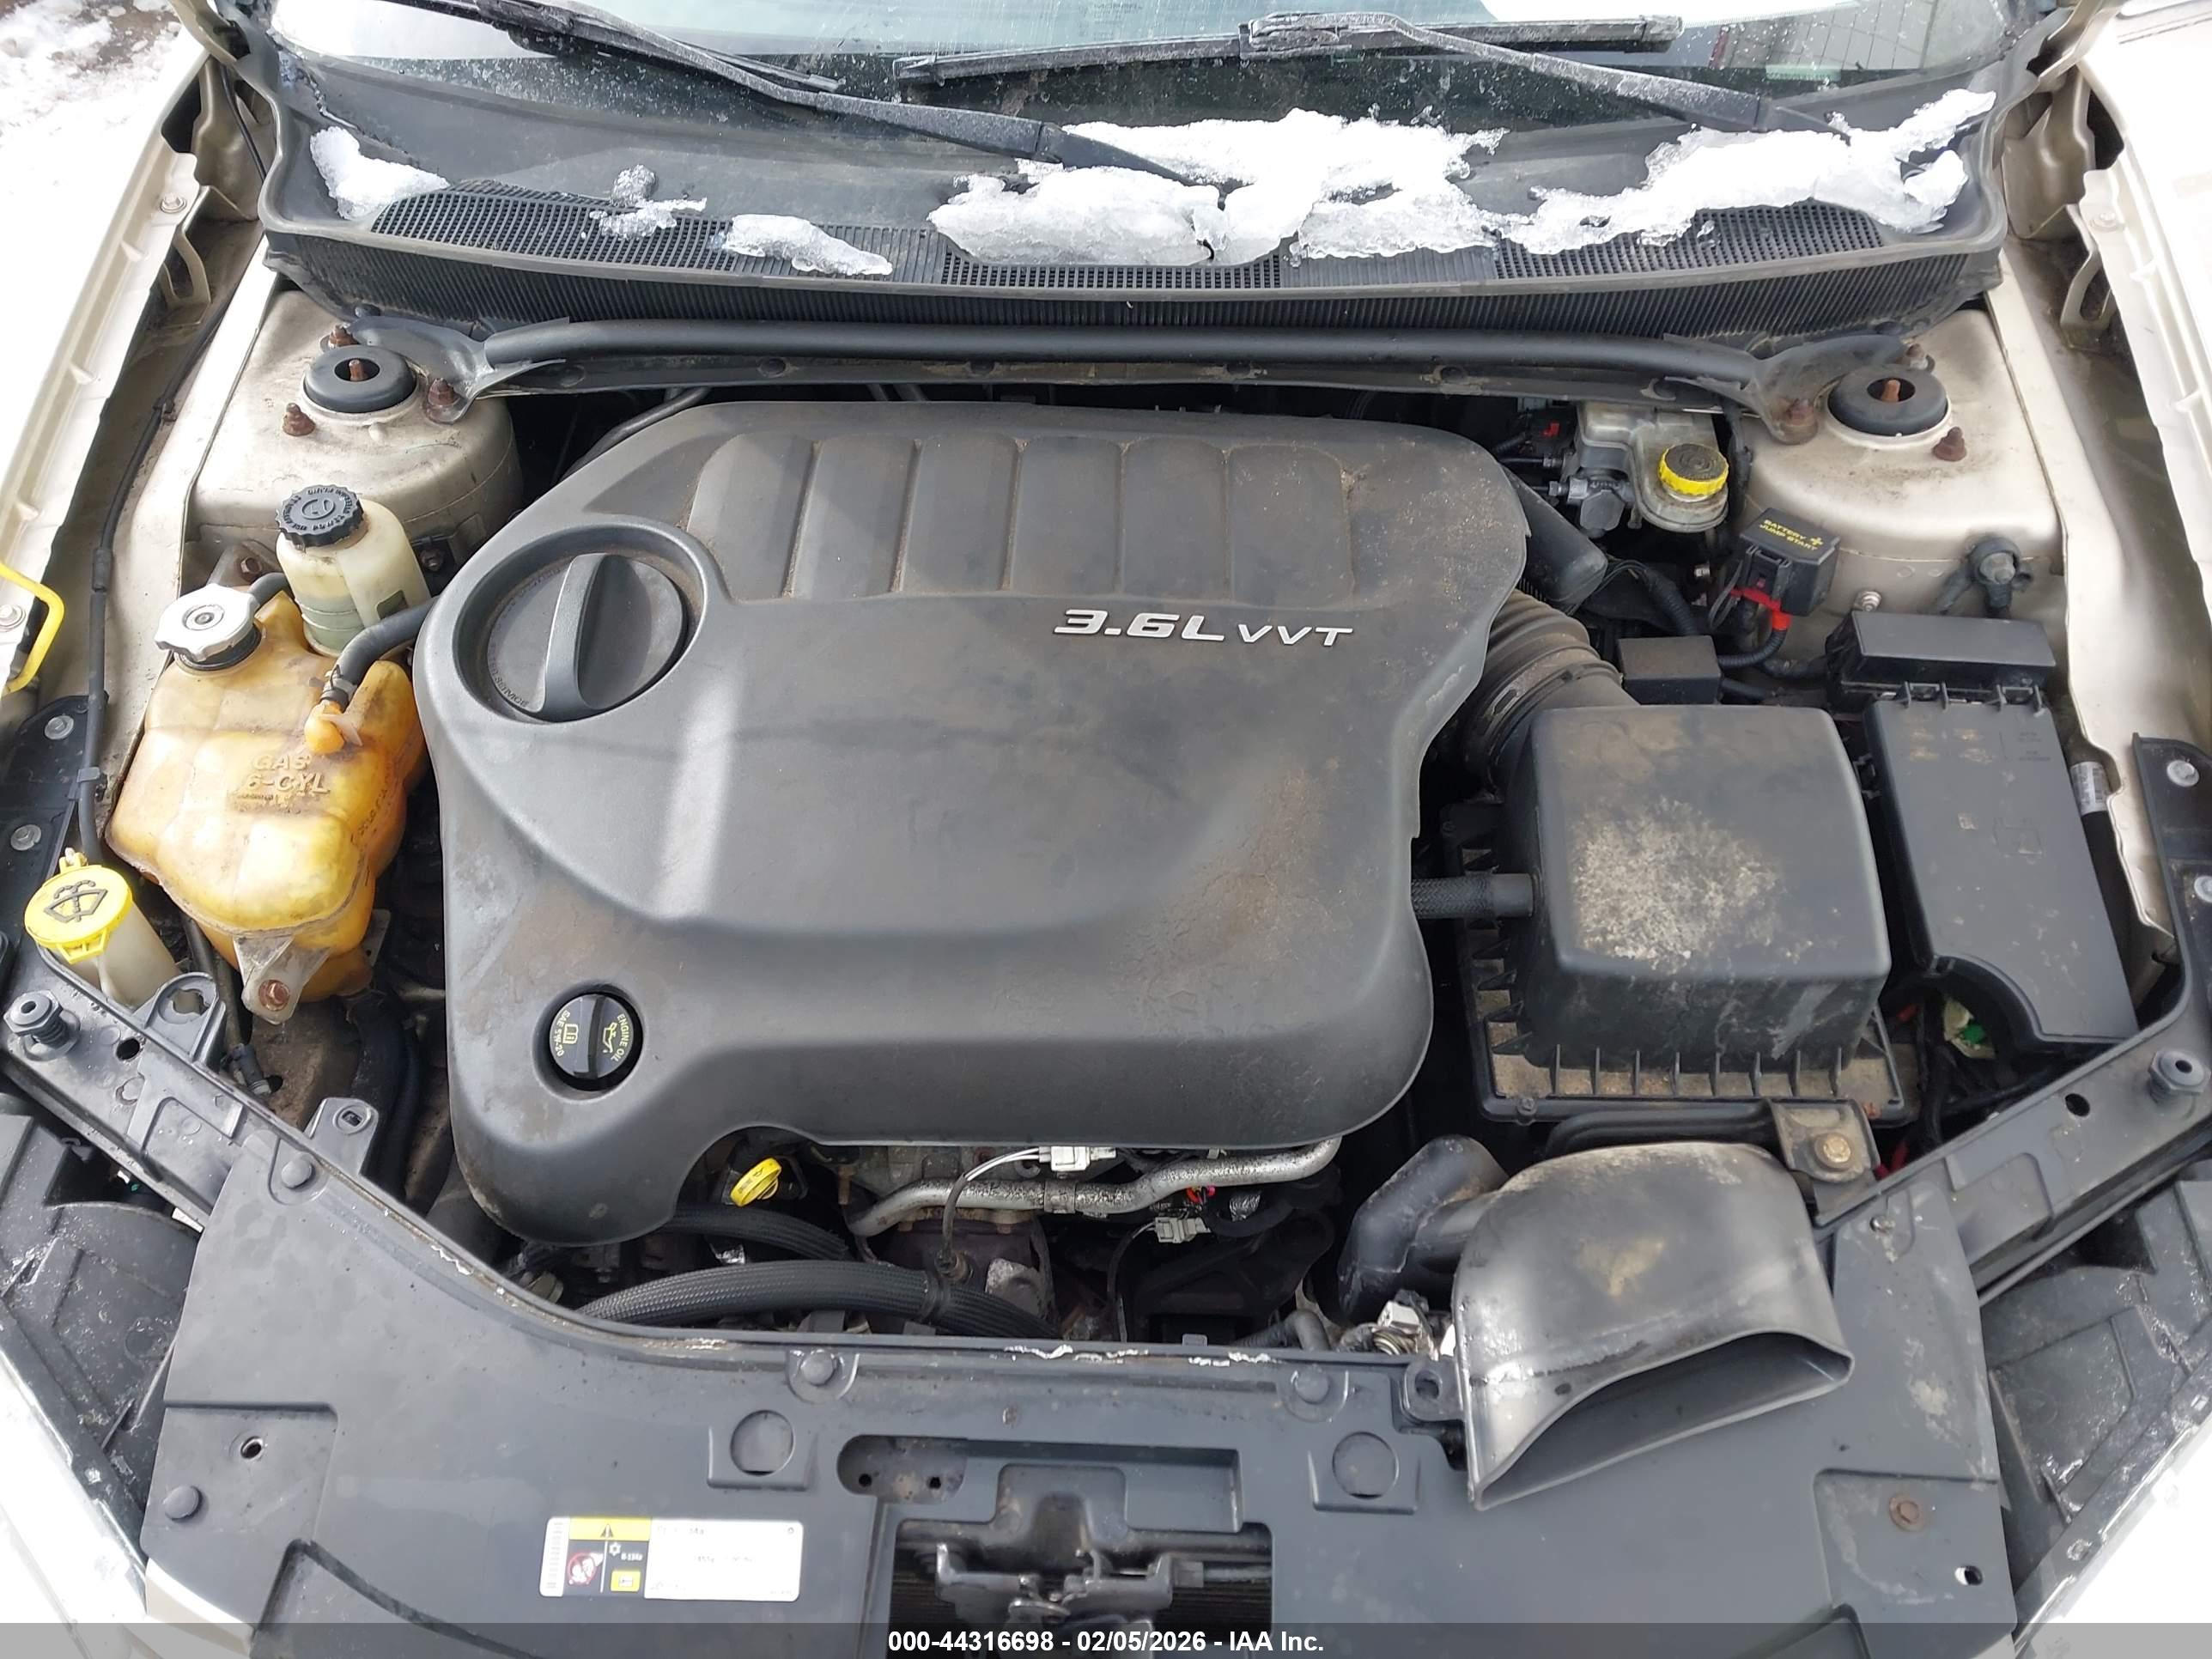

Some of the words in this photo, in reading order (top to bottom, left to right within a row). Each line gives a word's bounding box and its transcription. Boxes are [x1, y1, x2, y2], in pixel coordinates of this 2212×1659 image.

[1759, 524, 1786, 538] JUMP
[1786, 536, 1819, 550] START
[1764, 519, 1808, 539] BATTERY
[1054, 609, 1224, 641] 3.6L
[1237, 623, 1353, 647] VVT
[252, 755, 312, 771] GAS
[246, 773, 331, 795] 6-CYL
[556, 1010, 571, 1028] SAE
[617, 1013, 630, 1047] ENGINE
[611, 1048, 625, 1062] OIL
